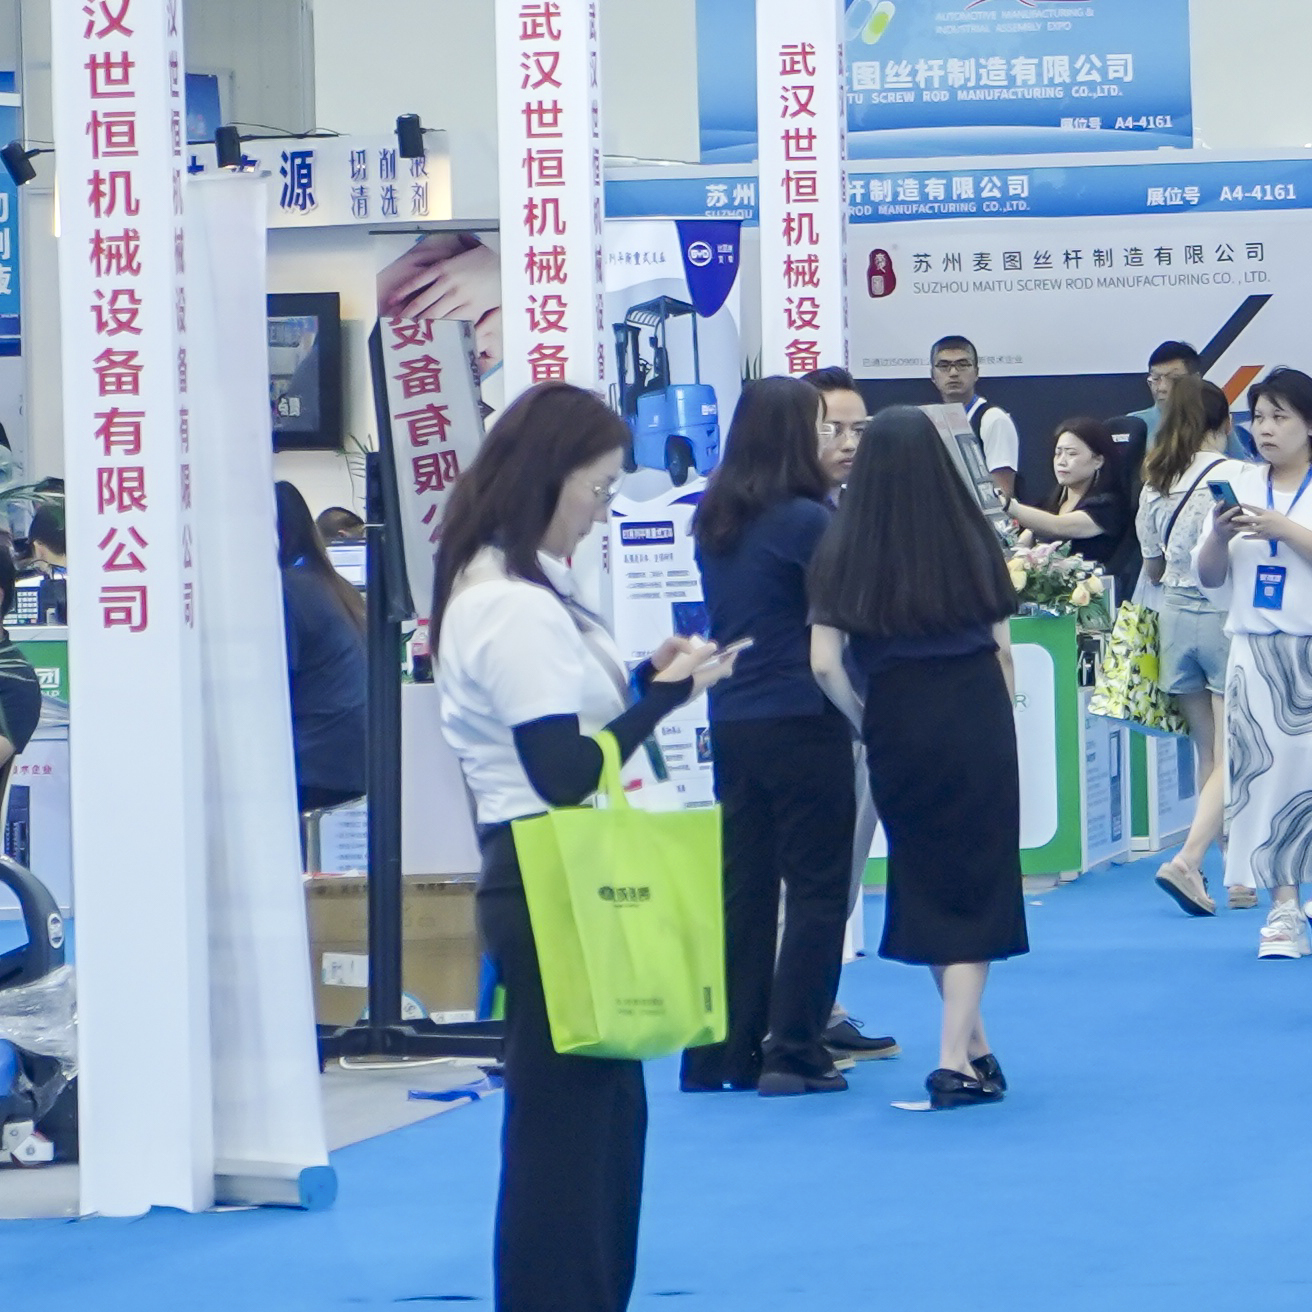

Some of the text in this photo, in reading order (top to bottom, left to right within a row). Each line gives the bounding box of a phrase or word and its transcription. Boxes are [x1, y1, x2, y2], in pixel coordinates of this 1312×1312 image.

[935, 10, 997, 21] AUTOMOTIVE
[871, 91, 915, 103] SCREW
[922, 90, 949, 102] ROD
[957, 87, 1064, 101] MANUFACTURING
[1060, 115, 1173, 131] 展位号 A4-4161
[347, 184, 430, 219] 清洗剂
[1146, 186, 1201, 206] 展位号
[1219, 184, 1297, 202] A4-4161
[878, 202, 976, 215] MANUFACTURING
[912, 241, 1265, 273] 苏州麦图丝杆制造有限公司
[912, 281, 972, 295] SUZHOU
[973, 279, 1014, 293] MAITU
[1017, 278, 1062, 292] SCREW
[1065, 277, 1093, 290] ROD
[1096, 272, 1210, 289] MANUFACTURING
